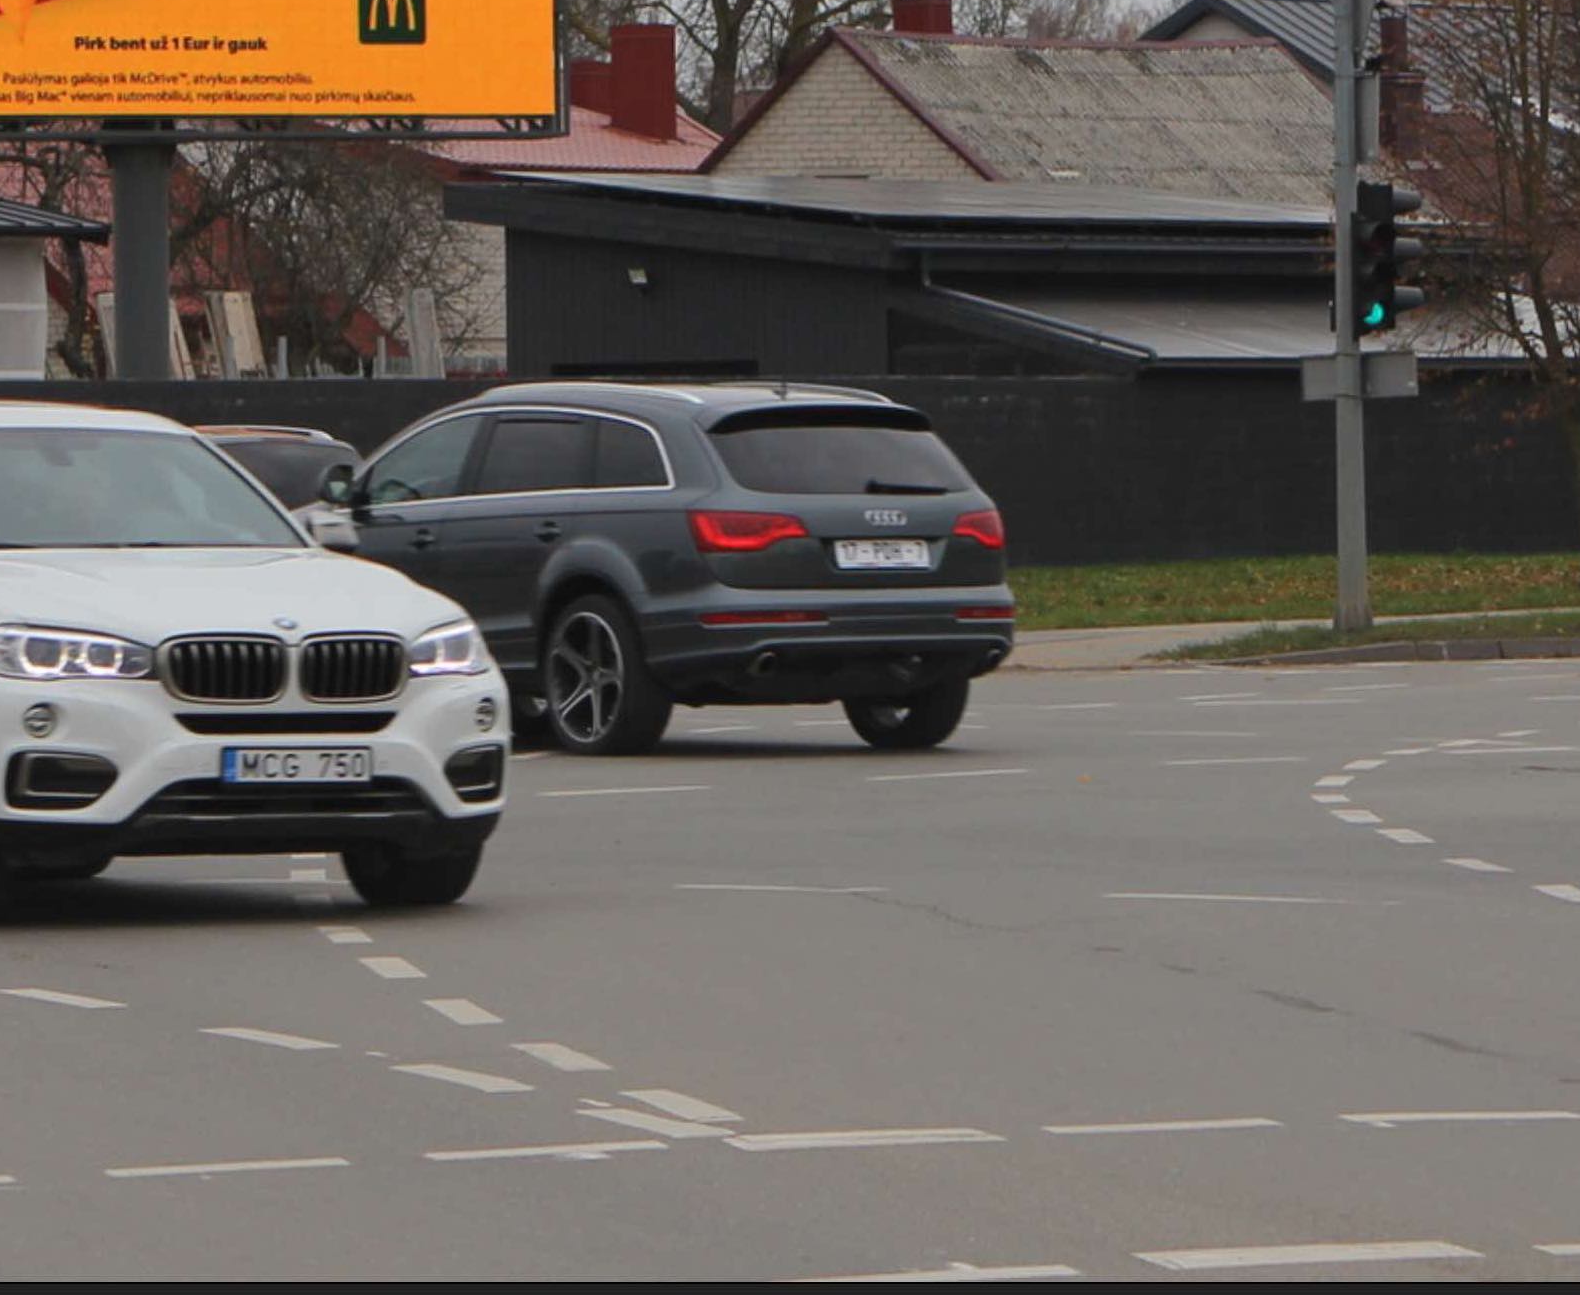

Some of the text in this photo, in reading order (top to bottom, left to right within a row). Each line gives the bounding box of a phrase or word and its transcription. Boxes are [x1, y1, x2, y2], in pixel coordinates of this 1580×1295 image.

[74, 35, 268, 55] Pirk bent už 1 Eur ir gauk
[242, 753, 365, 778] MCG 750
